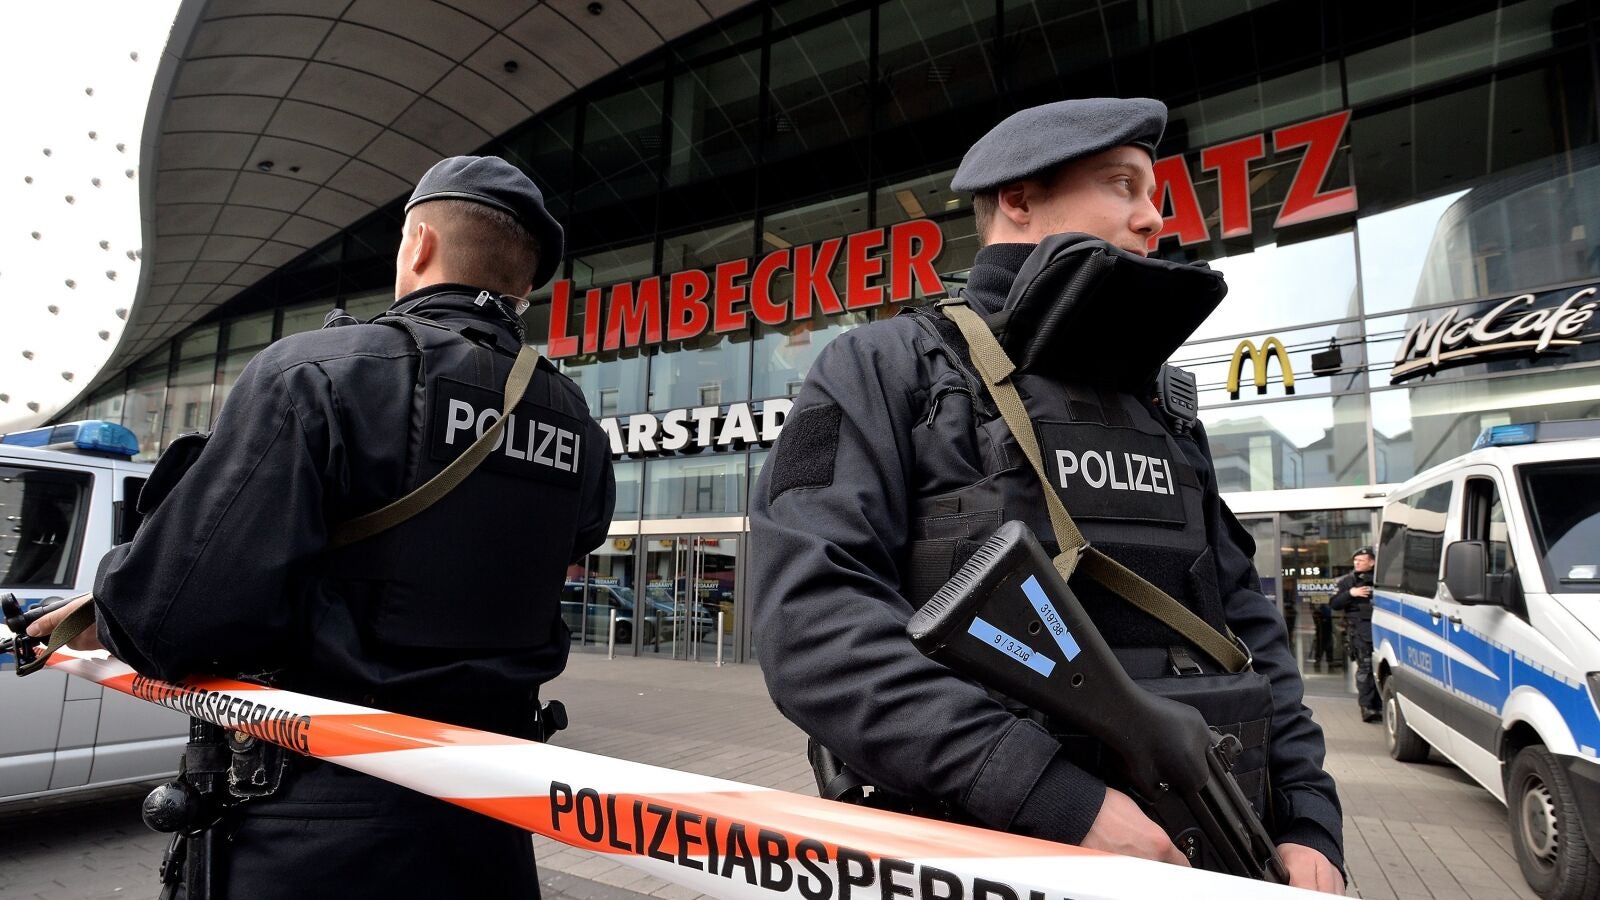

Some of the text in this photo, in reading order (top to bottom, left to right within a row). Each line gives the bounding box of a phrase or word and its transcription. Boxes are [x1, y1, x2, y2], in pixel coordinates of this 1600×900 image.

[547, 218, 946, 359] LIMBECKER
[1393, 287, 1597, 366] McCafé
[445, 398, 581, 474] POLIZEI
[1055, 449, 1175, 495] POLIZEI
[1040, 604, 1064, 636] 319738
[994, 634, 1002, 644] 9
[1007, 641, 1030, 662] 3.Zug
[1407, 645, 1433, 673] POLIZEI
